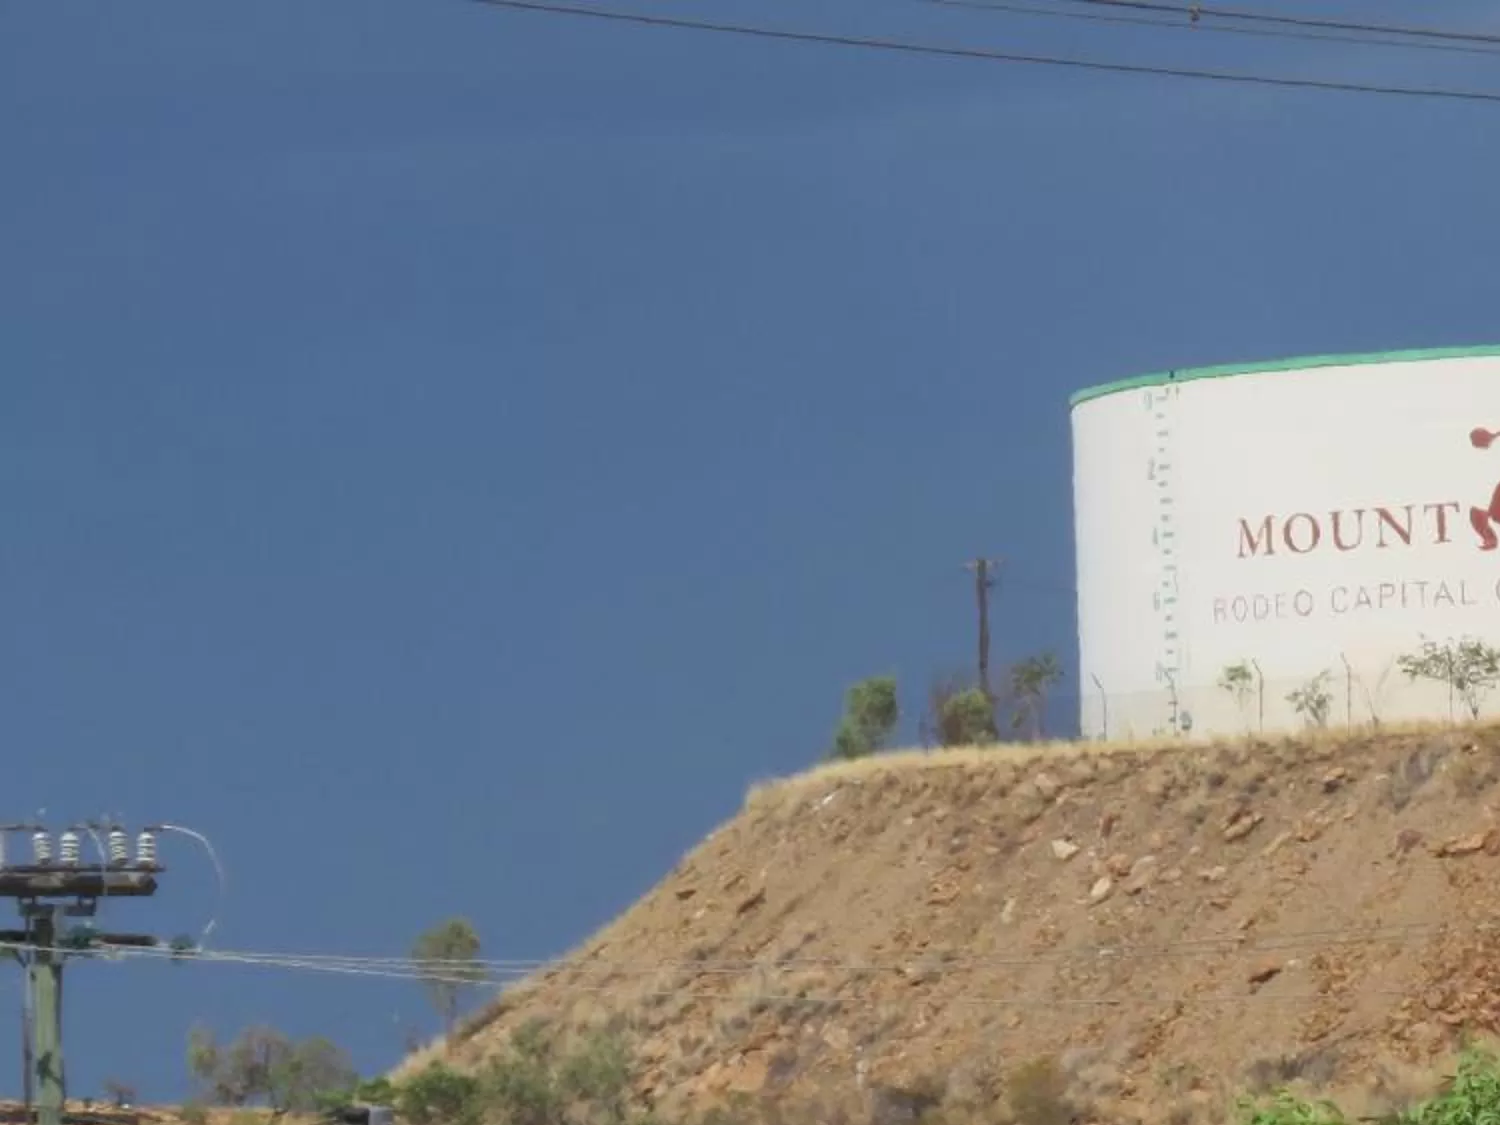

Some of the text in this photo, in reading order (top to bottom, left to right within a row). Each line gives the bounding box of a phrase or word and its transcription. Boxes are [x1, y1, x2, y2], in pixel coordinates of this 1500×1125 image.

[1237, 501, 1461, 558] MOUNT
[1212, 588, 1314, 624] RODEO
[1330, 578, 1478, 614] CAPITAL
